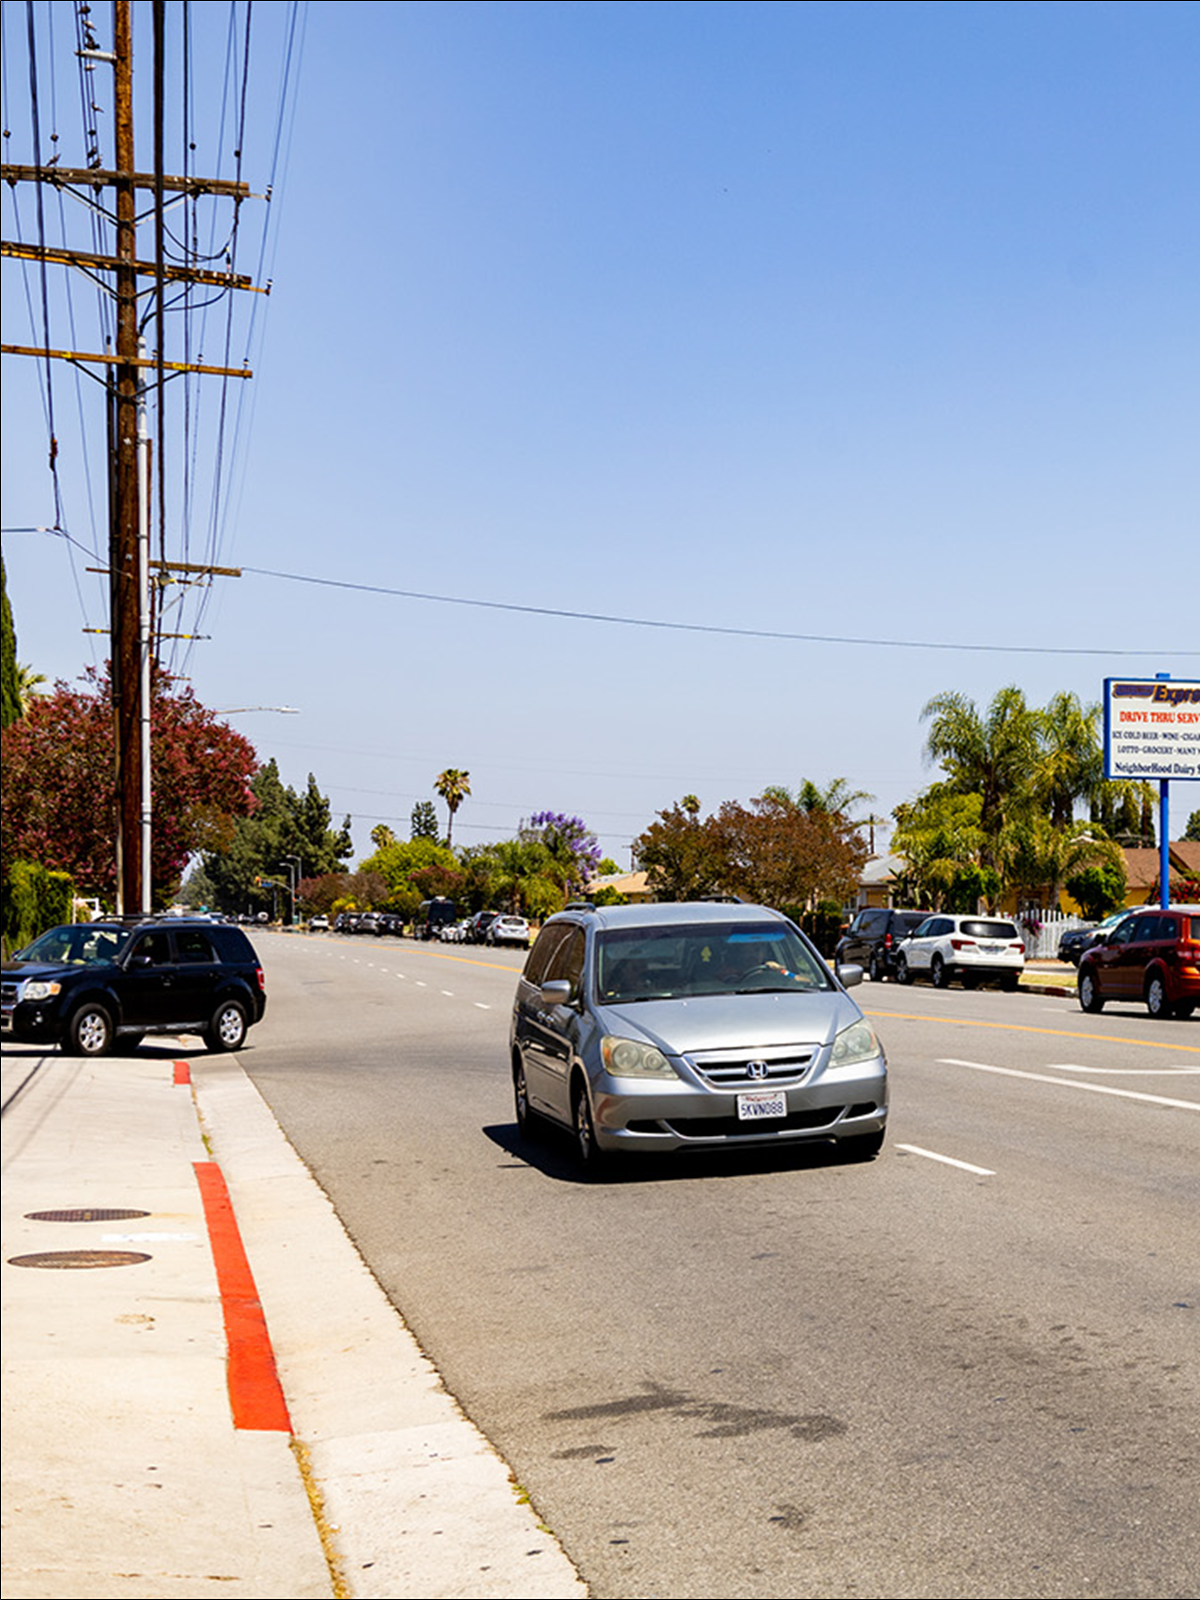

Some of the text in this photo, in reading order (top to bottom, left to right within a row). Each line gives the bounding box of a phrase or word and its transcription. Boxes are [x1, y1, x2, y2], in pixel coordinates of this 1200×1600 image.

[1119, 711, 1149, 723] DRIVE
[1150, 712, 1176, 723] THRU
[1123, 731, 1141, 740] COLD
[1142, 732, 1159, 740] BEER
[1174, 763, 1195, 776] Dairy
